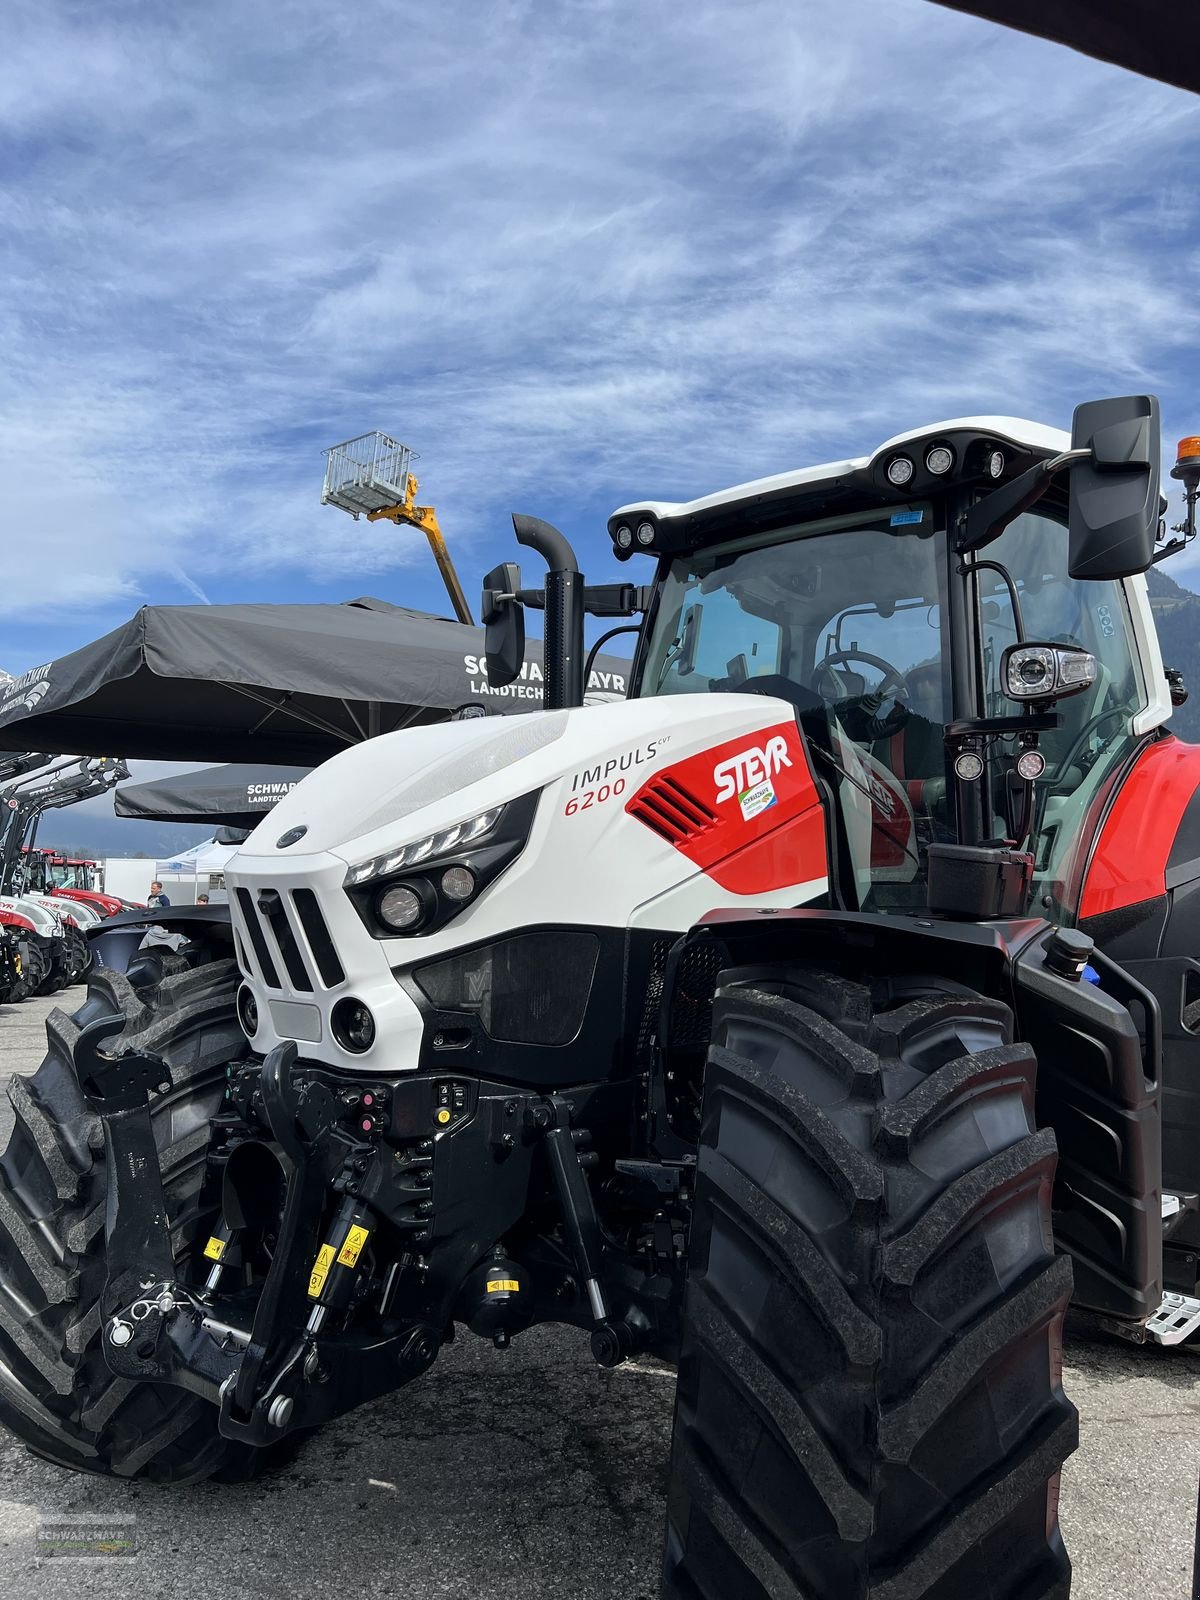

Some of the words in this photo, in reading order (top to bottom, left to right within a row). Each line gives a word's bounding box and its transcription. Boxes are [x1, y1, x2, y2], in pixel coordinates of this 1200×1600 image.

[571, 741, 657, 792] IMPULS
[658, 735, 671, 745] CVT
[713, 735, 793, 804] STEYR
[565, 778, 626, 816] 6200
